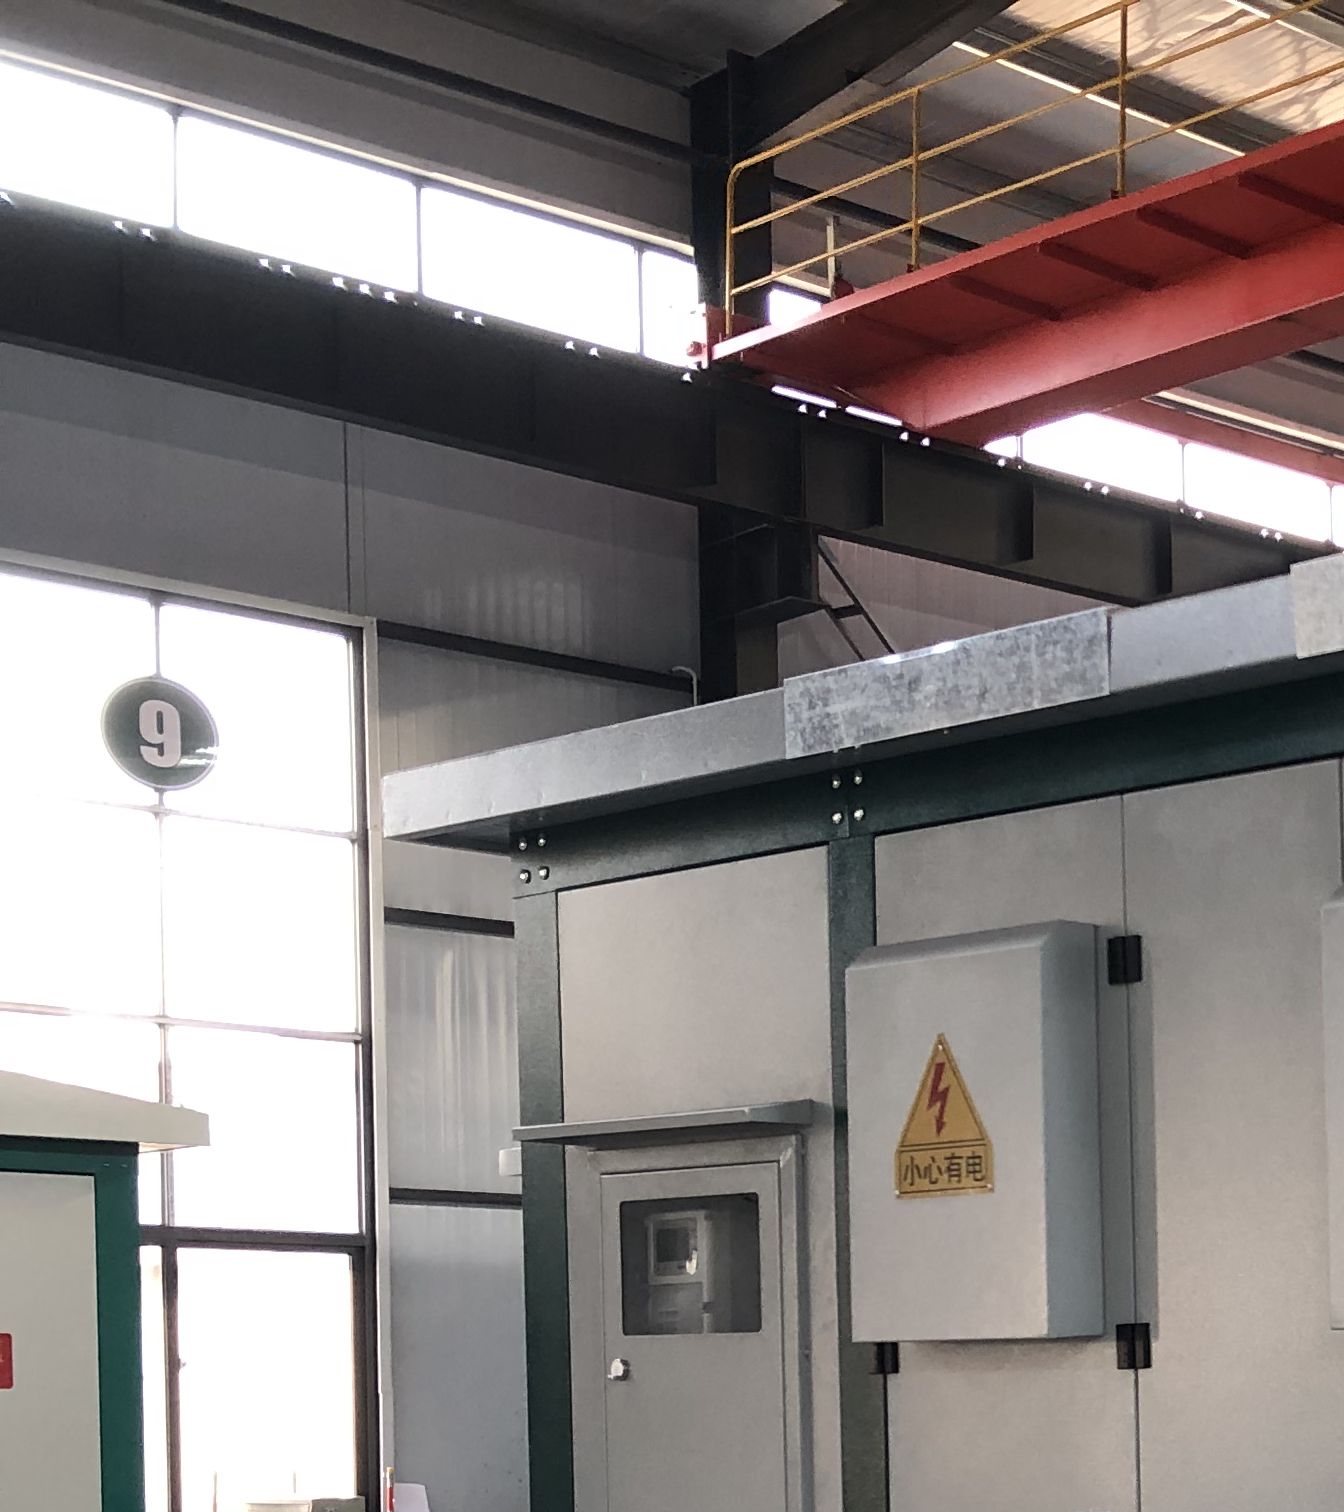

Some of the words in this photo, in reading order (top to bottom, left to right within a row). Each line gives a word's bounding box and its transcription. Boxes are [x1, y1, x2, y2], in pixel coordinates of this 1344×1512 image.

[139, 699, 181, 768] 9
[903, 1151, 986, 1186] 小心有电
